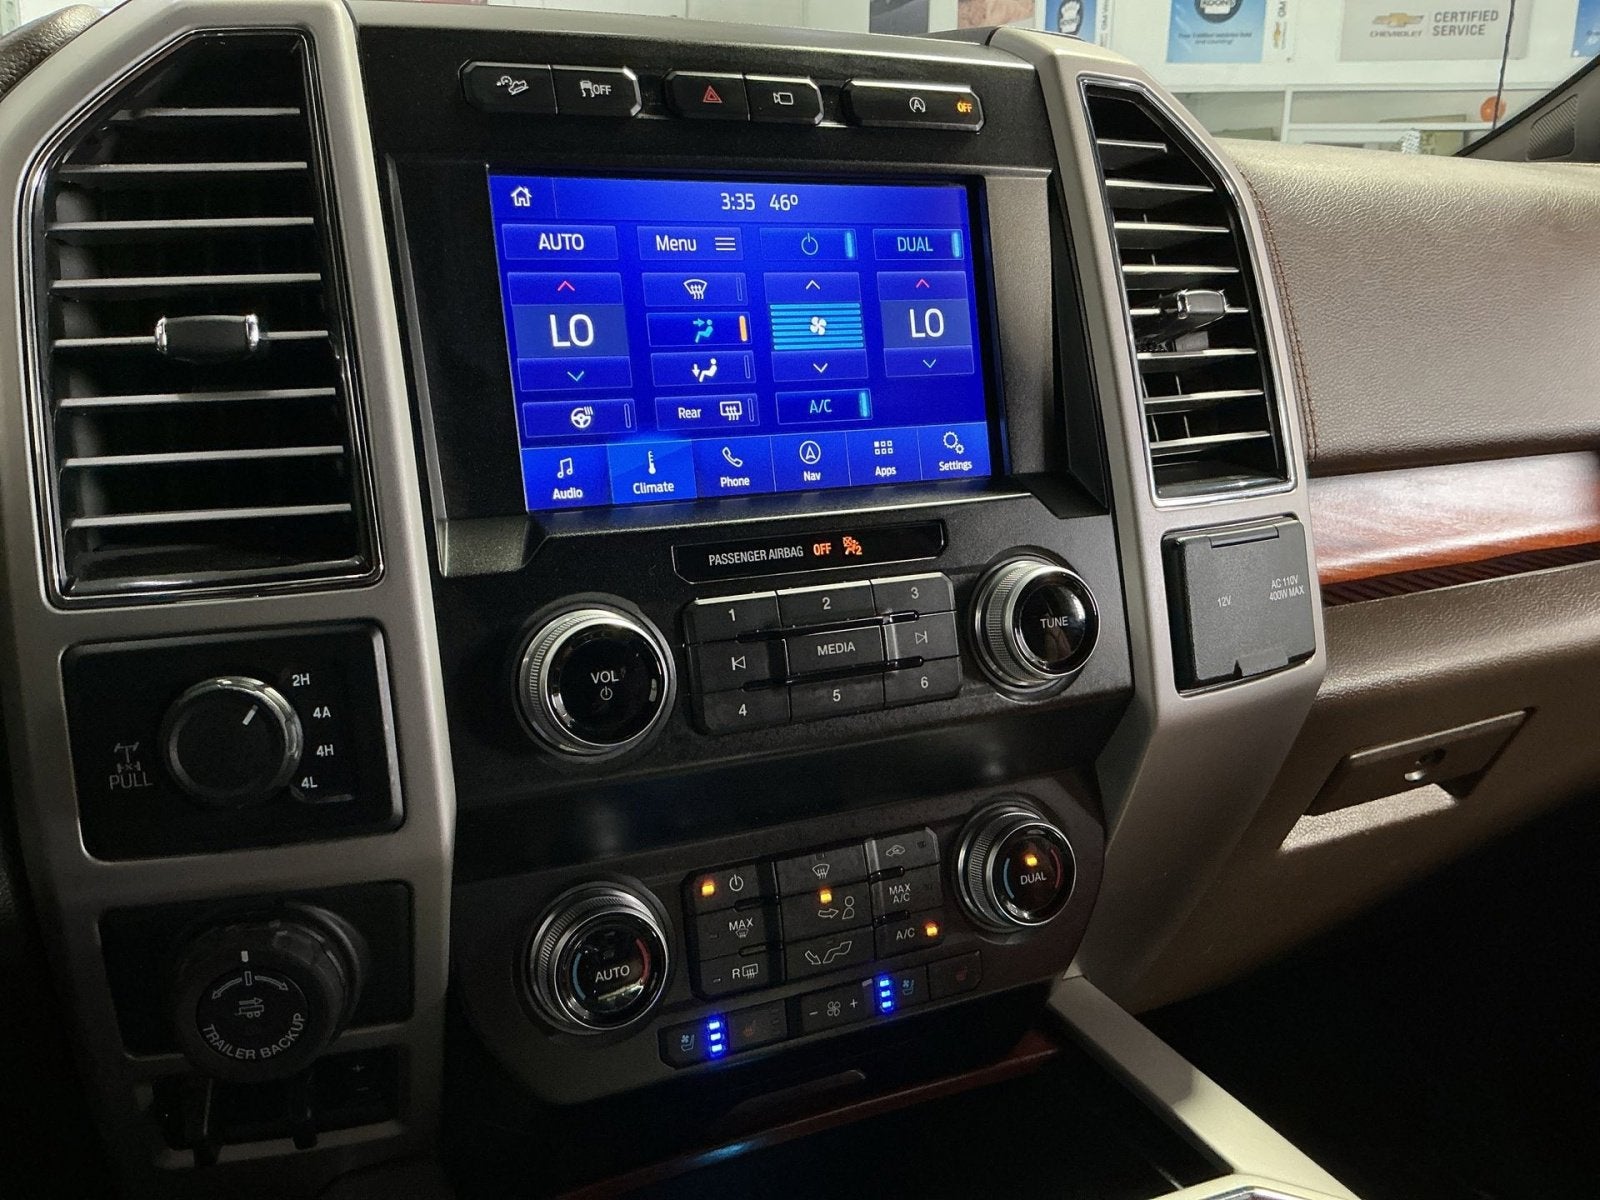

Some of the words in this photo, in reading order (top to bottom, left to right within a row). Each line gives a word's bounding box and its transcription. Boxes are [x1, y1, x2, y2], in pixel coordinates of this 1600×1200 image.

[1434, 10, 1499, 23] CERTIFIED
[1369, 30, 1422, 38] CHEVROLET
[1432, 24, 1486, 36] SERVICE
[593, 84, 612, 96] OFF
[957, 101, 972, 112] OFF
[721, 193, 755, 211] 3:35
[538, 233, 585, 251] AUTO
[656, 235, 697, 252] Menu
[897, 236, 934, 252] DUAL
[909, 308, 945, 338] LO
[549, 313, 594, 347] LO
[678, 406, 702, 420] Rear
[809, 399, 832, 414] A/C
[875, 465, 897, 478] Apps
[938, 459, 973, 472] Settings
[720, 474, 750, 488] Phone
[803, 470, 822, 482] Nav
[552, 487, 583, 500] Audio
[633, 481, 675, 495] Climate
[708, 551, 767, 566] PASSENGER
[768, 546, 804, 560] AIRBAG
[813, 543, 832, 556] OFF
[1271, 578, 1281, 589] AC
[1282, 574, 1299, 587] 110V
[910, 586, 919, 599] 3
[1269, 588, 1287, 601] 400W
[1288, 585, 1305, 598] MAX
[822, 597, 831, 610] 2
[1217, 595, 1231, 607] 12V
[728, 609, 736, 622] 1
[1040, 616, 1068, 629] TUNE
[817, 641, 856, 657] MEDIA
[292, 673, 310, 687] 2H
[590, 670, 619, 684] VOL
[920, 676, 929, 689] 6
[832, 689, 841, 702] 5
[313, 706, 331, 719] 4A
[738, 703, 748, 717] 4
[316, 744, 334, 757] 4H
[109, 771, 152, 790] PULL
[301, 776, 318, 789] 4L
[1020, 872, 1047, 885] DUAL
[888, 883, 911, 896] MAX
[893, 892, 911, 904] A/C
[728, 917, 754, 932] MAX
[896, 928, 915, 941] A/C
[595, 964, 630, 982] AUTO
[732, 968, 741, 979] R
[202, 1024, 257, 1060] TRAILER
[260, 1012, 306, 1059] BACKUP
